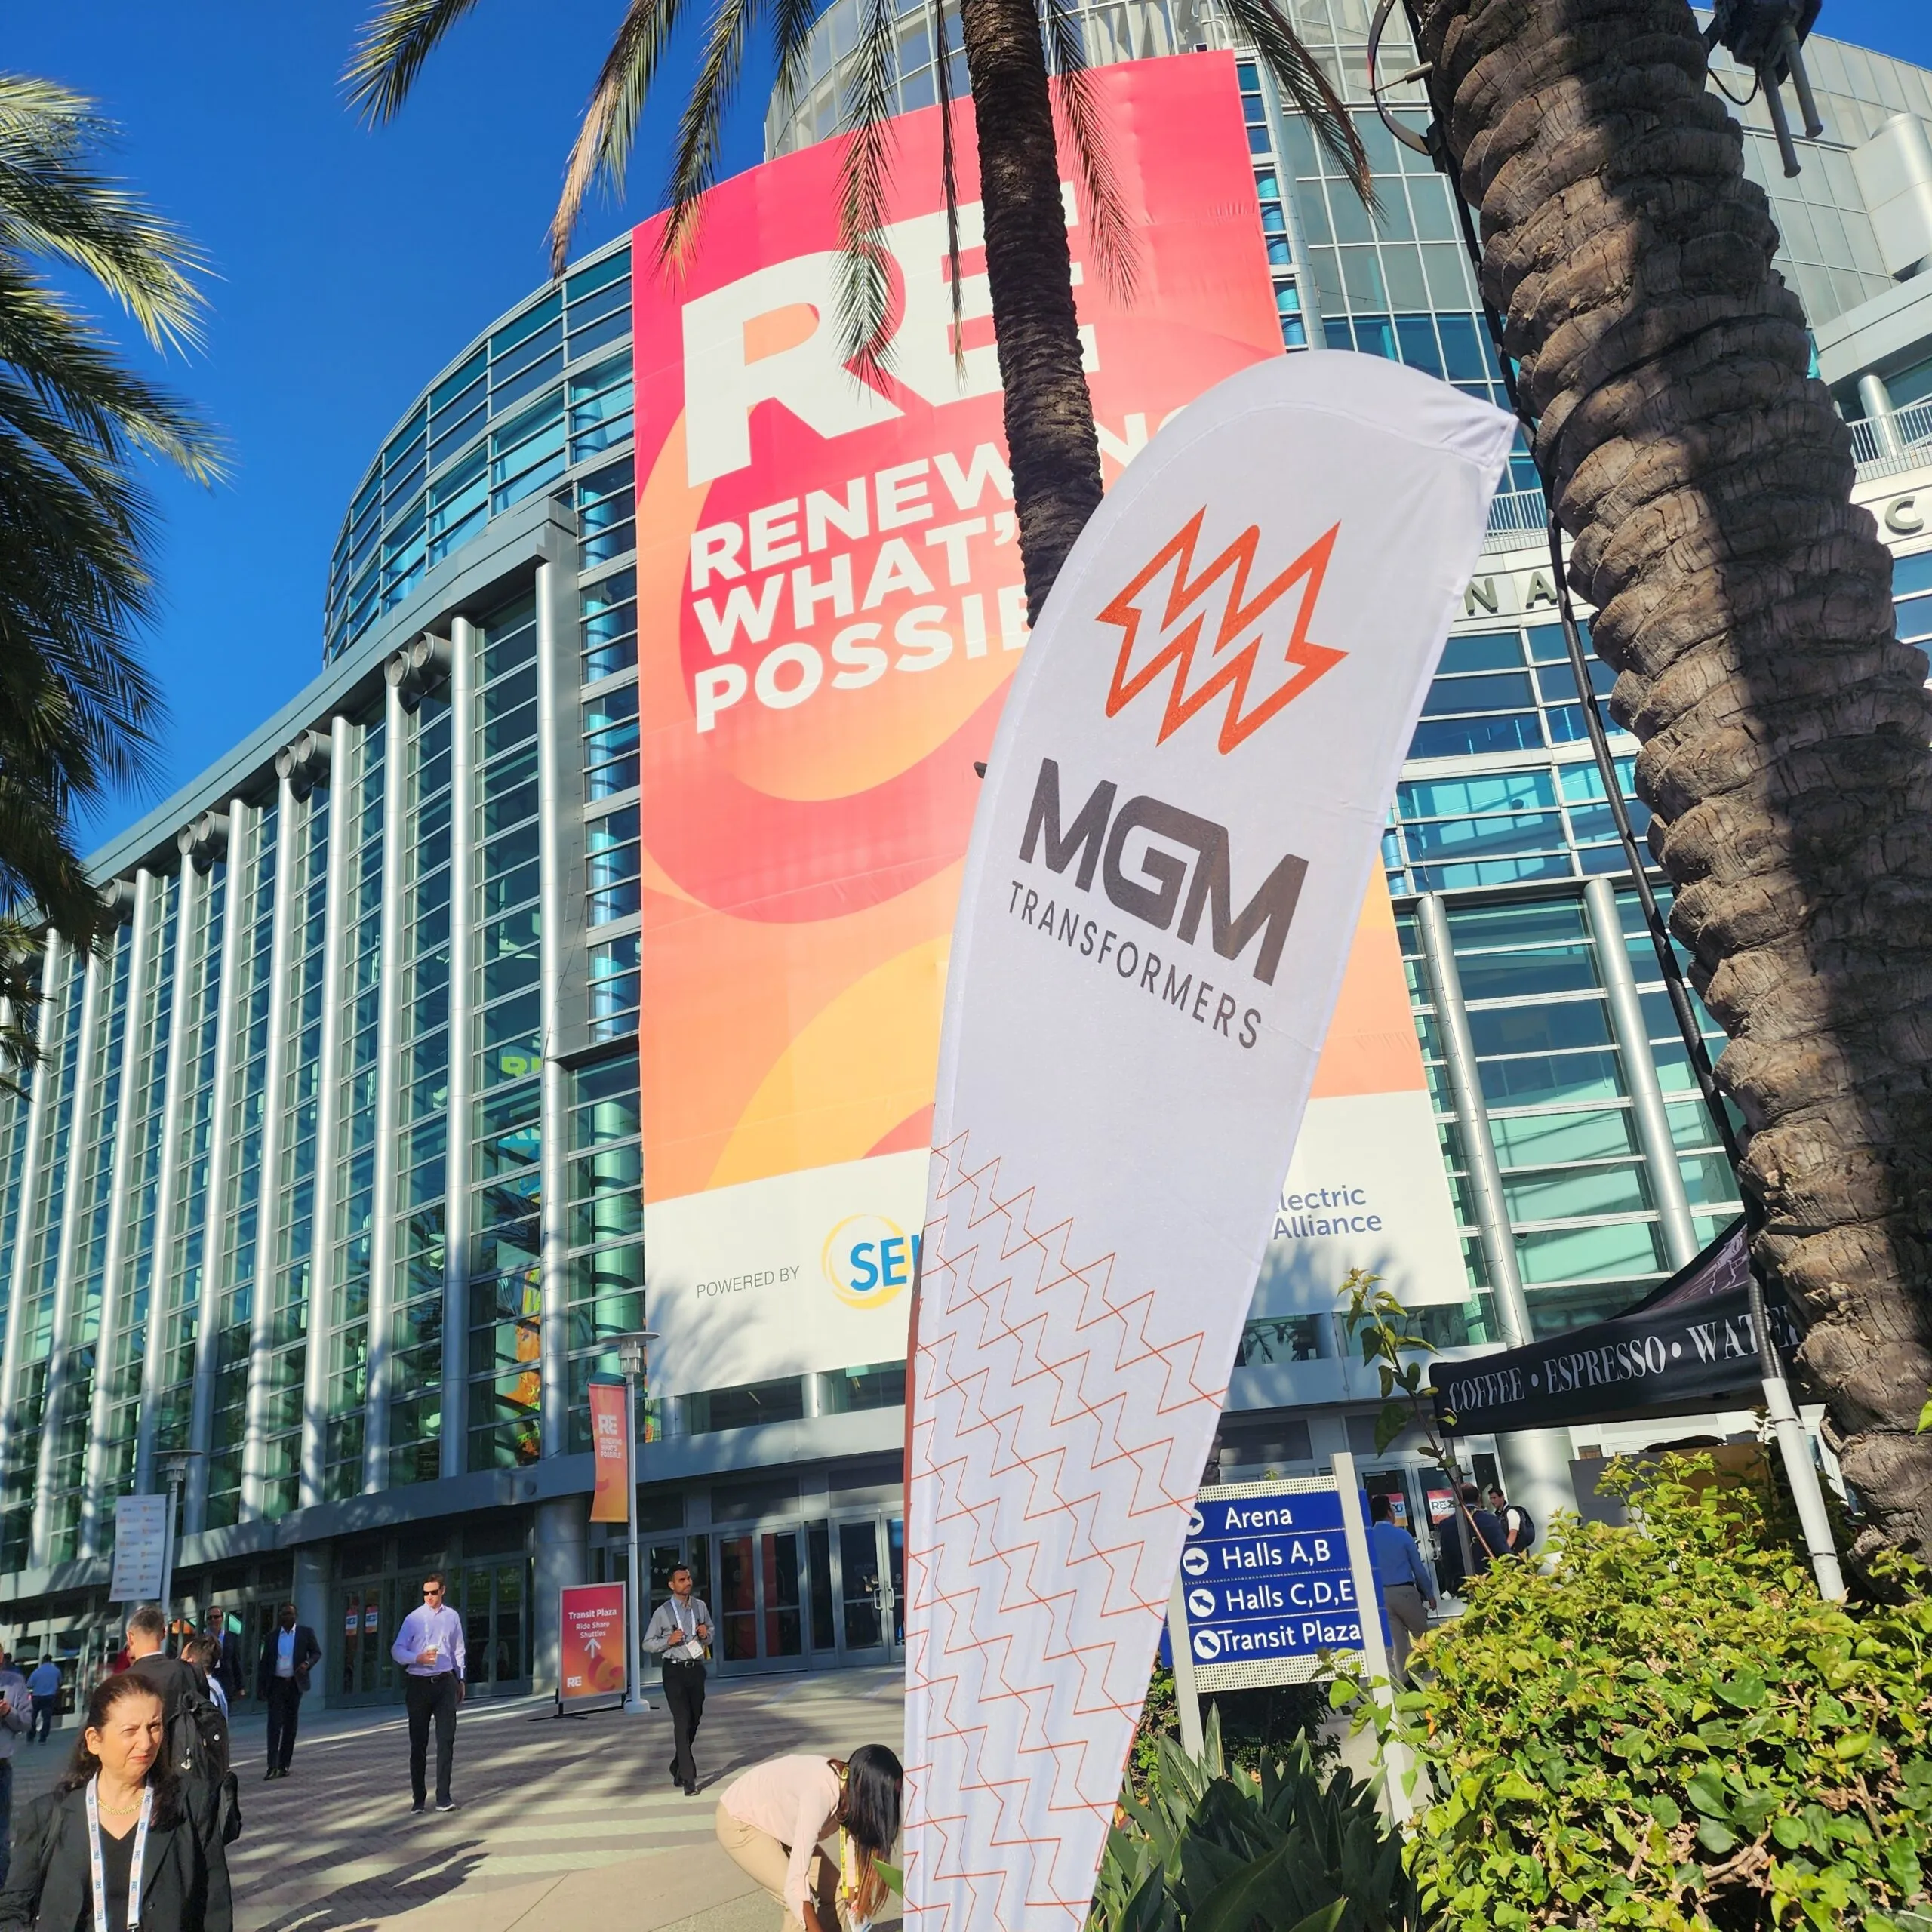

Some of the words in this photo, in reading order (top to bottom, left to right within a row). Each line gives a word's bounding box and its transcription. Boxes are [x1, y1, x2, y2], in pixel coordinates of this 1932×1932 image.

[682, 180, 1100, 488] RE
[1019, 758, 1309, 986] MGM
[1008, 881, 1262, 1049] TRANSFORMERS
[1277, 1185, 1367, 1212] lectric
[1273, 1215, 1383, 1240] Alliance
[697, 1271, 775, 1298] POWERED
[780, 1265, 800, 1284] BY
[1448, 1367, 1525, 1414] COFFEE
[1546, 1335, 1666, 1394] ESPRESSO
[598, 1414, 617, 1435] RE
[1225, 1506, 1293, 1530] Arena
[1222, 1542, 1283, 1570] Halls
[1290, 1539, 1331, 1567] A,B
[1226, 1585, 1284, 1611] Halls
[1290, 1580, 1355, 1608] C,D,E
[568, 1609, 595, 1620] Transit
[596, 1608, 617, 1617] Plaza
[580, 1630, 606, 1639] Shuttles
[1217, 1625, 1297, 1652] Transit
[1302, 1620, 1361, 1644] Plaza
[567, 1676, 582, 1688] RE
